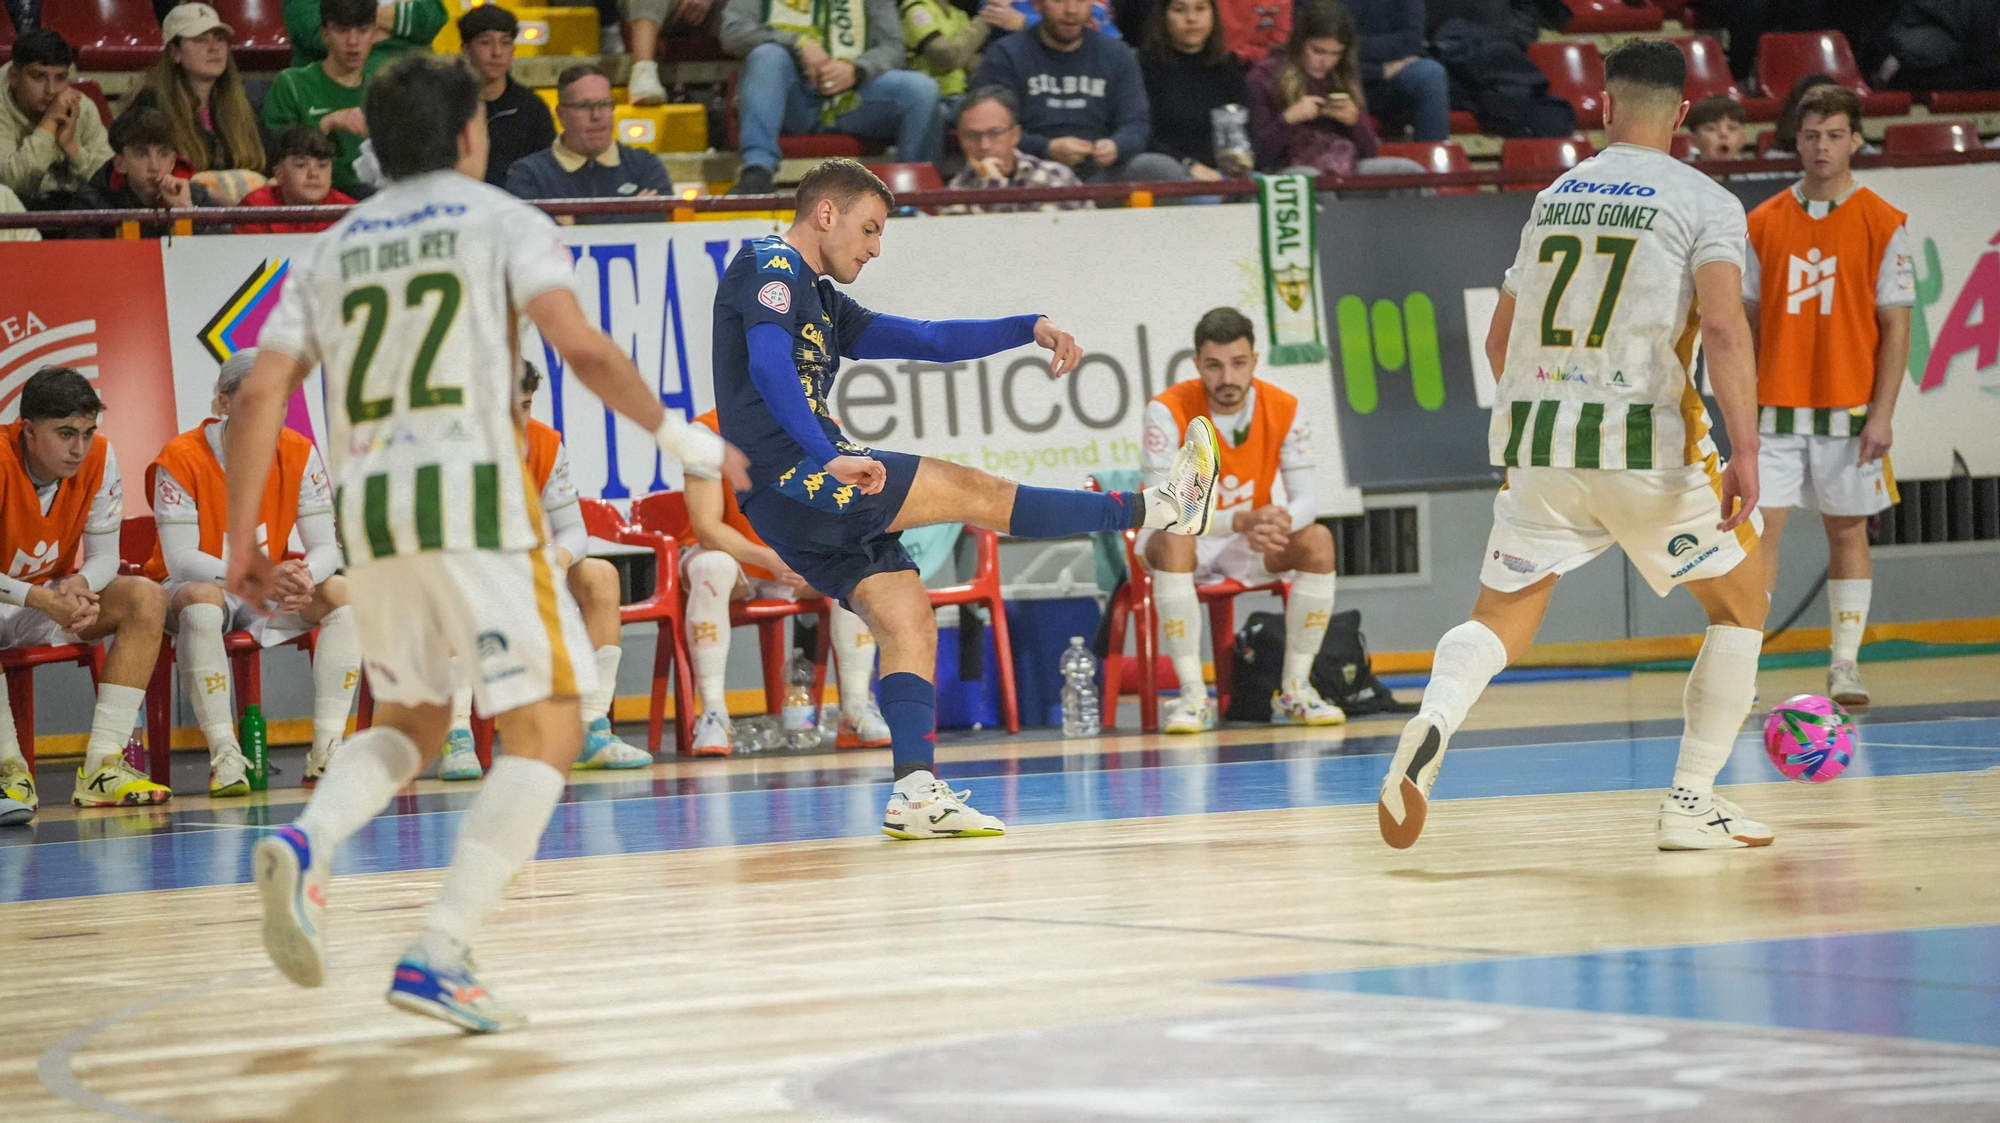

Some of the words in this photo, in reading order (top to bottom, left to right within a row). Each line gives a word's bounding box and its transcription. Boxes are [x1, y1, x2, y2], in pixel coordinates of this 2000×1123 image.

[1554, 179, 1656, 197] Revalco
[1274, 178, 1300, 255] UTSAL
[1537, 202, 1595, 226] CARLOS
[1597, 201, 1659, 231] GÓMEZ
[419, 228, 460, 259] REY
[1538, 235, 1638, 349] 27
[342, 272, 465, 426] 22
[982, 439, 1100, 476] beyond
[1110, 437, 1142, 463] th
